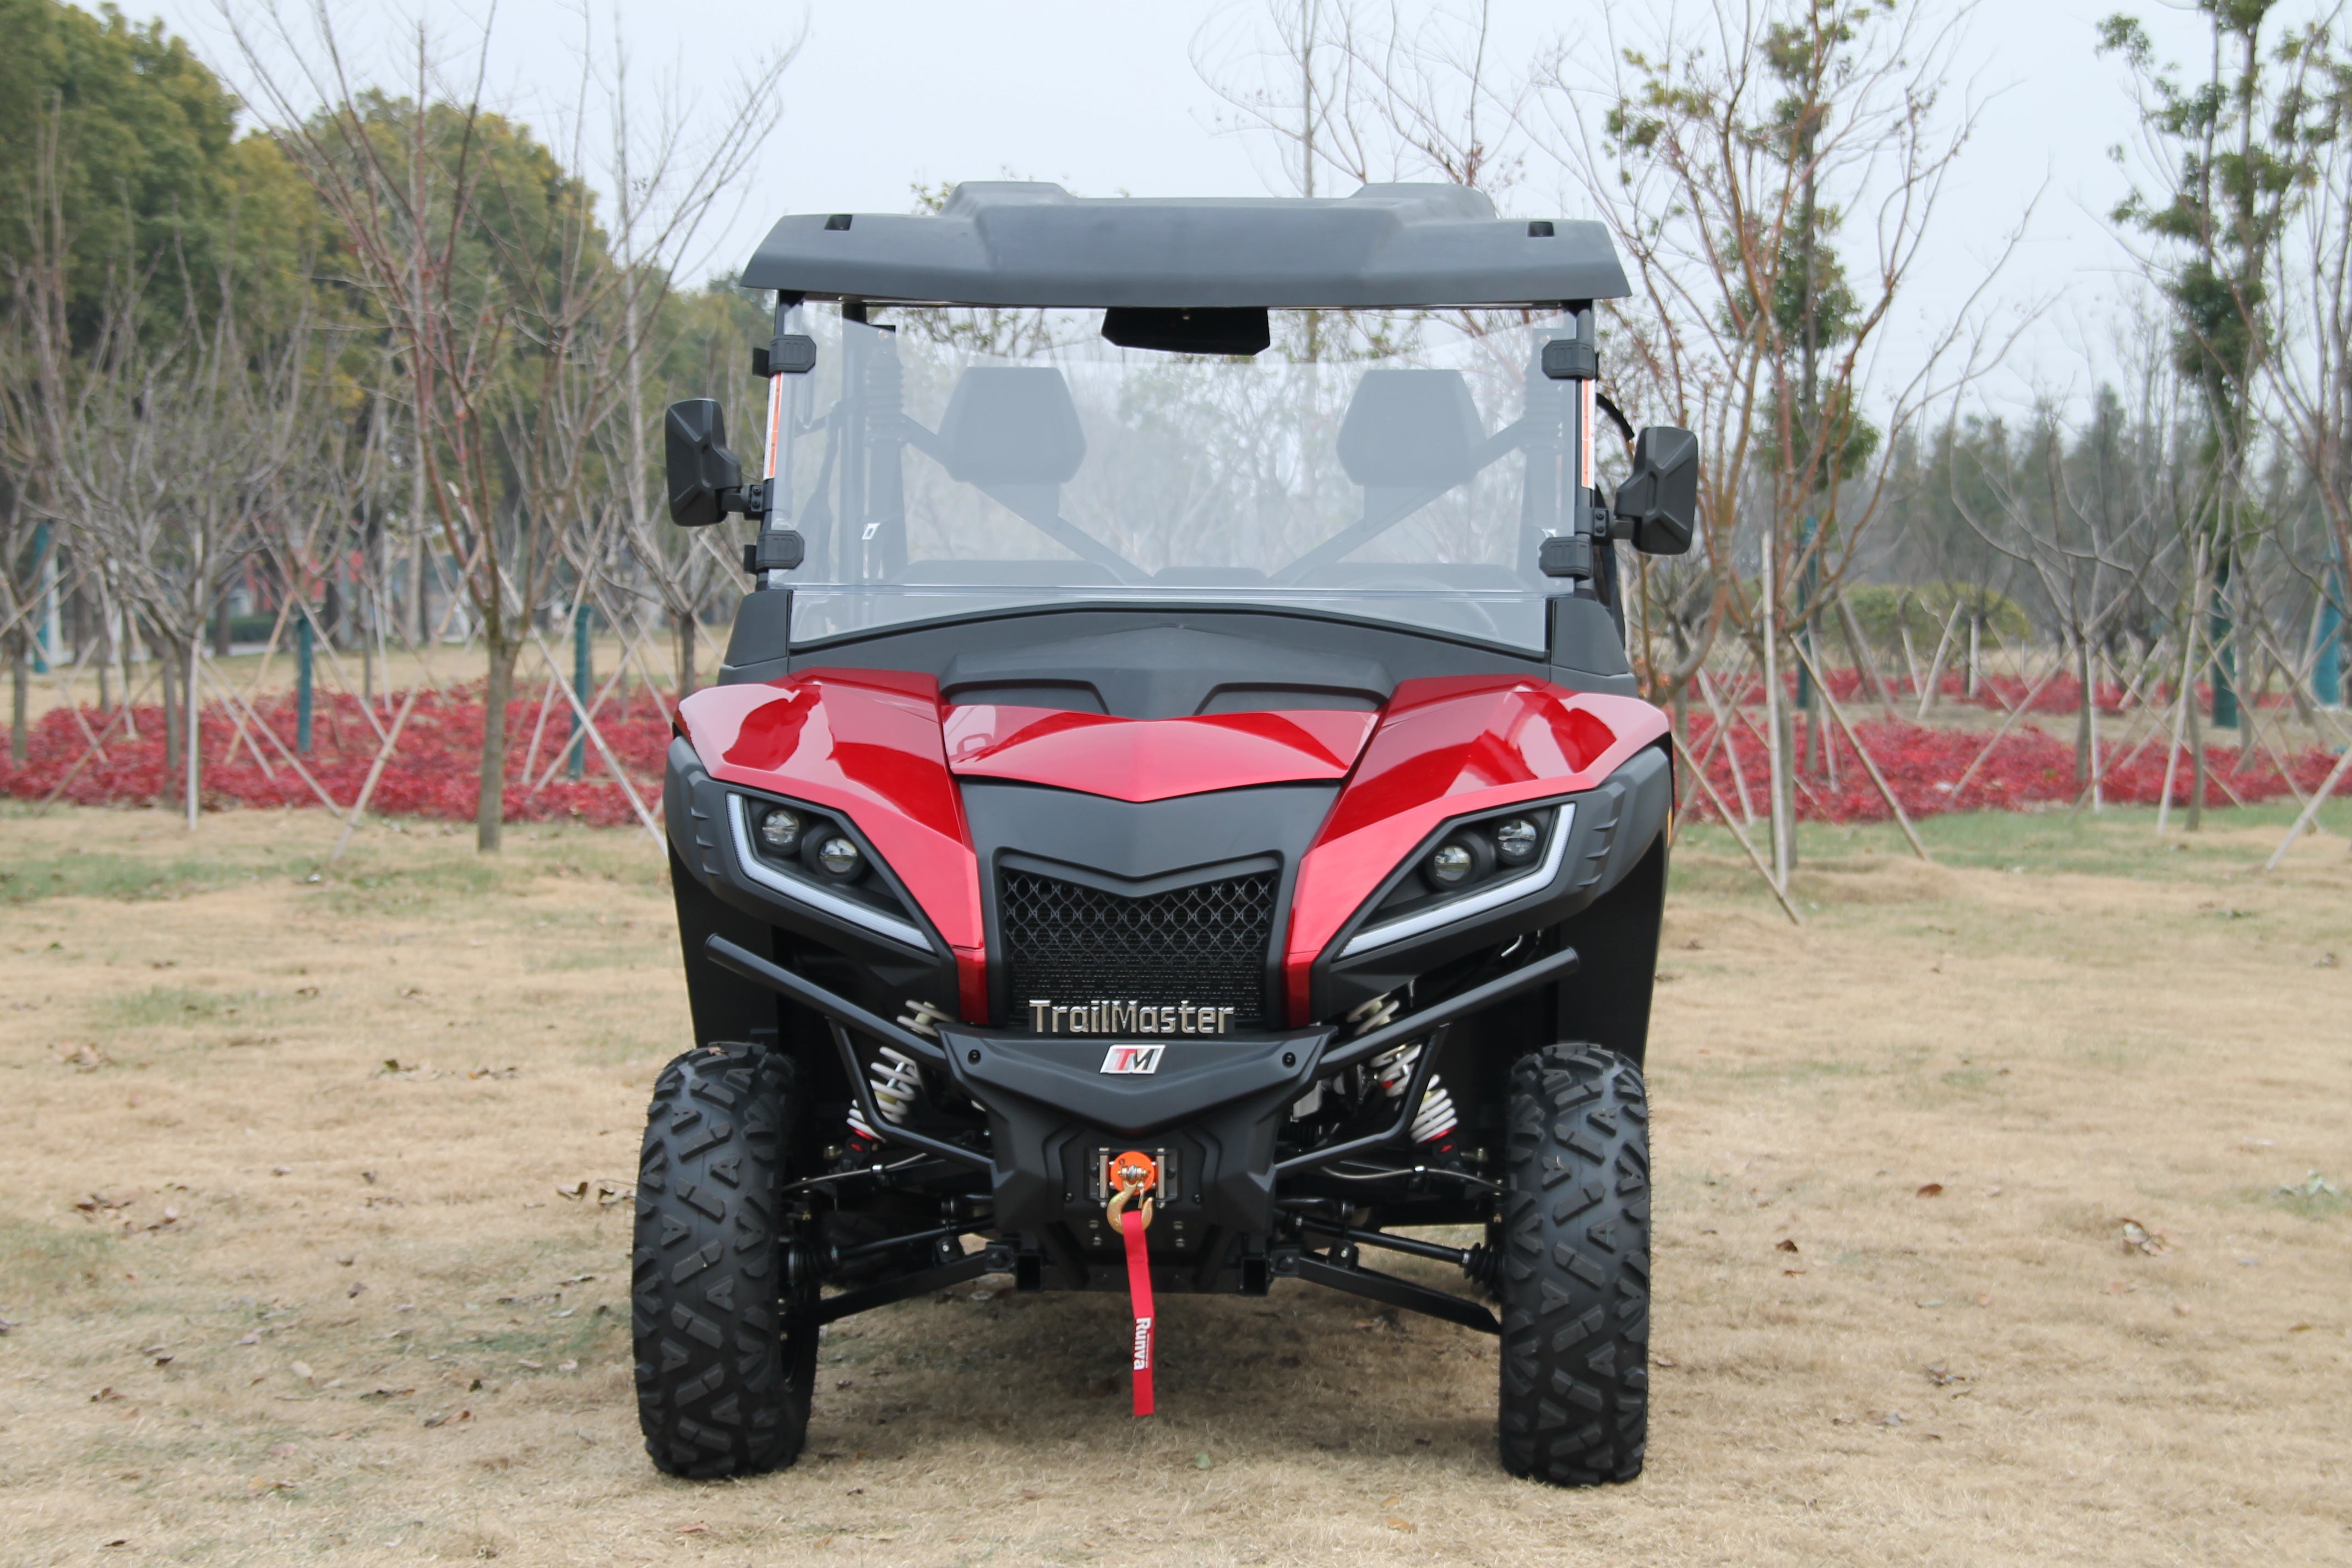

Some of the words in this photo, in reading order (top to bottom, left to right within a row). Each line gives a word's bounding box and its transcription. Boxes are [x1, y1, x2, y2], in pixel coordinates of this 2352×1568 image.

[1029, 1000, 1234, 1034] TrailMaster
[1114, 1048, 1155, 1071] TM
[1133, 1317, 1151, 1370] Runva
